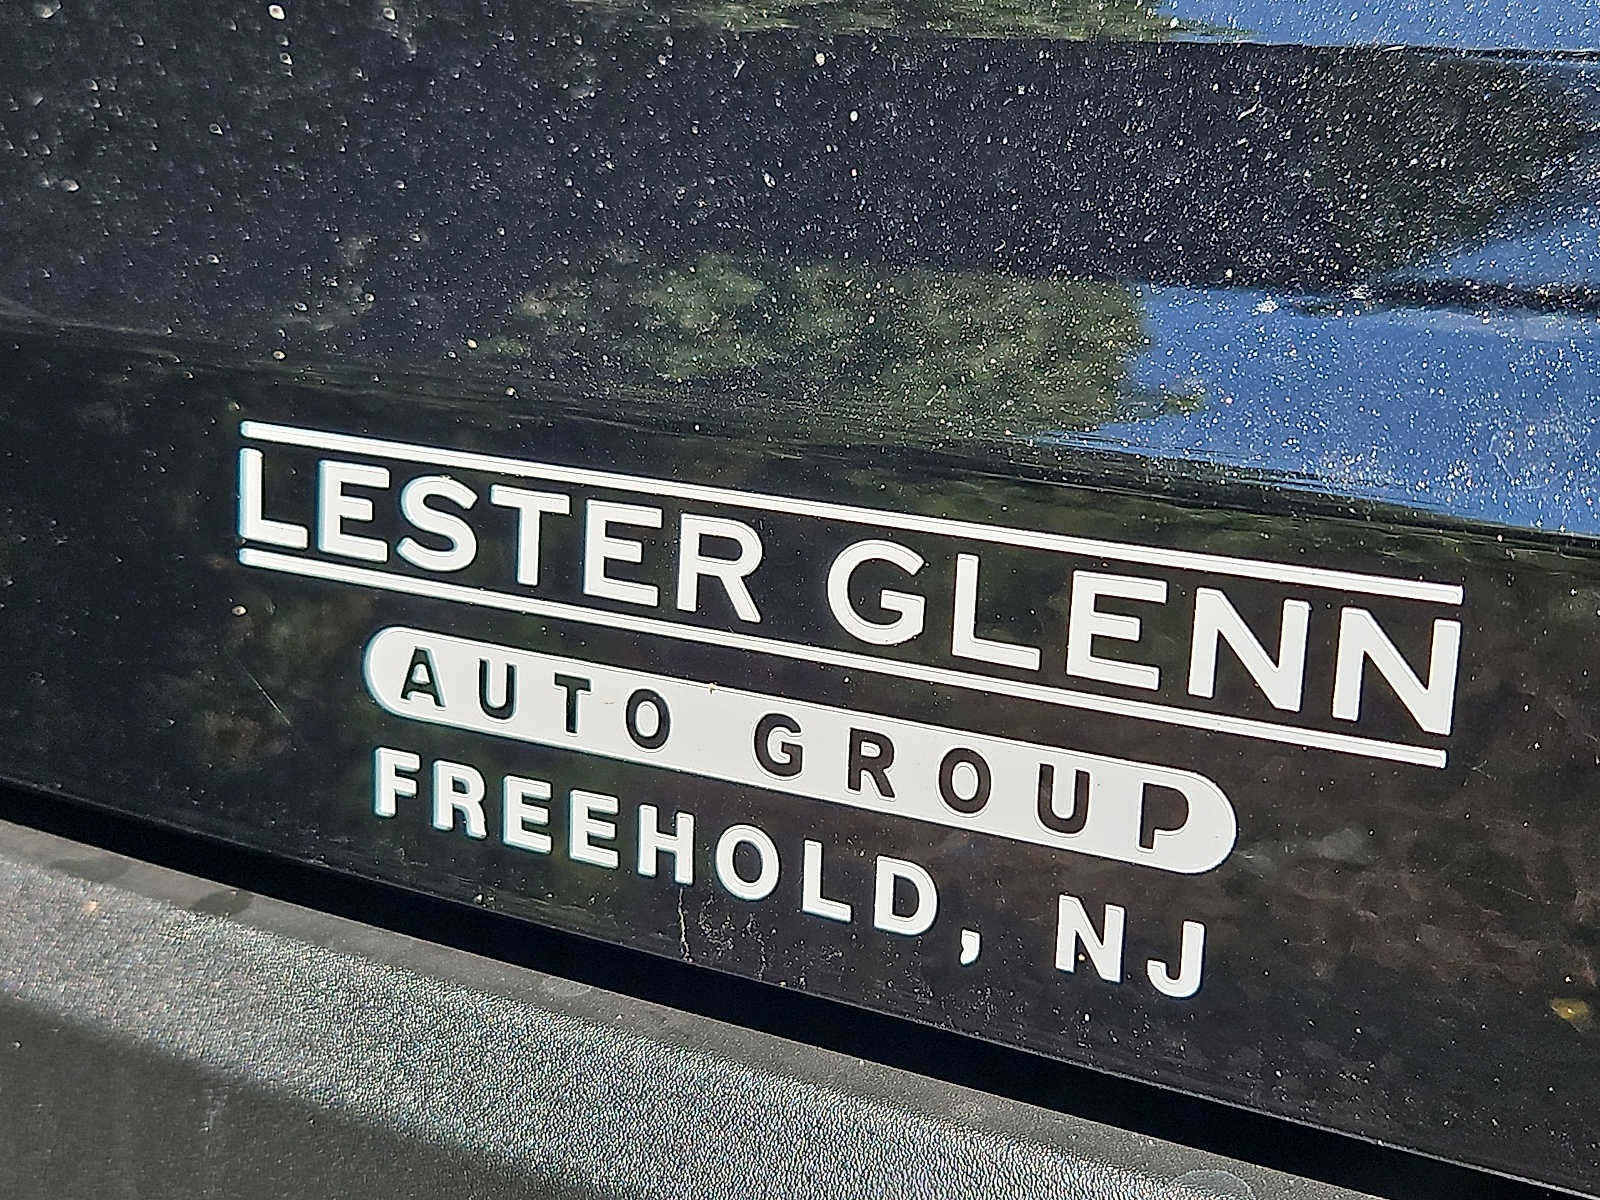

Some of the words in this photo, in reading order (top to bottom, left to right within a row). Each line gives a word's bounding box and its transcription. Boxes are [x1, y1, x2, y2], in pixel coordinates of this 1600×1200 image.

[239, 447, 763, 623] LESTER
[827, 540, 1461, 736] GLENN
[374, 747, 981, 966] FREEHOLD,
[1055, 894, 1206, 999] NJ
[400, 645, 672, 751] AUTO
[753, 712, 1191, 851] GROUP
